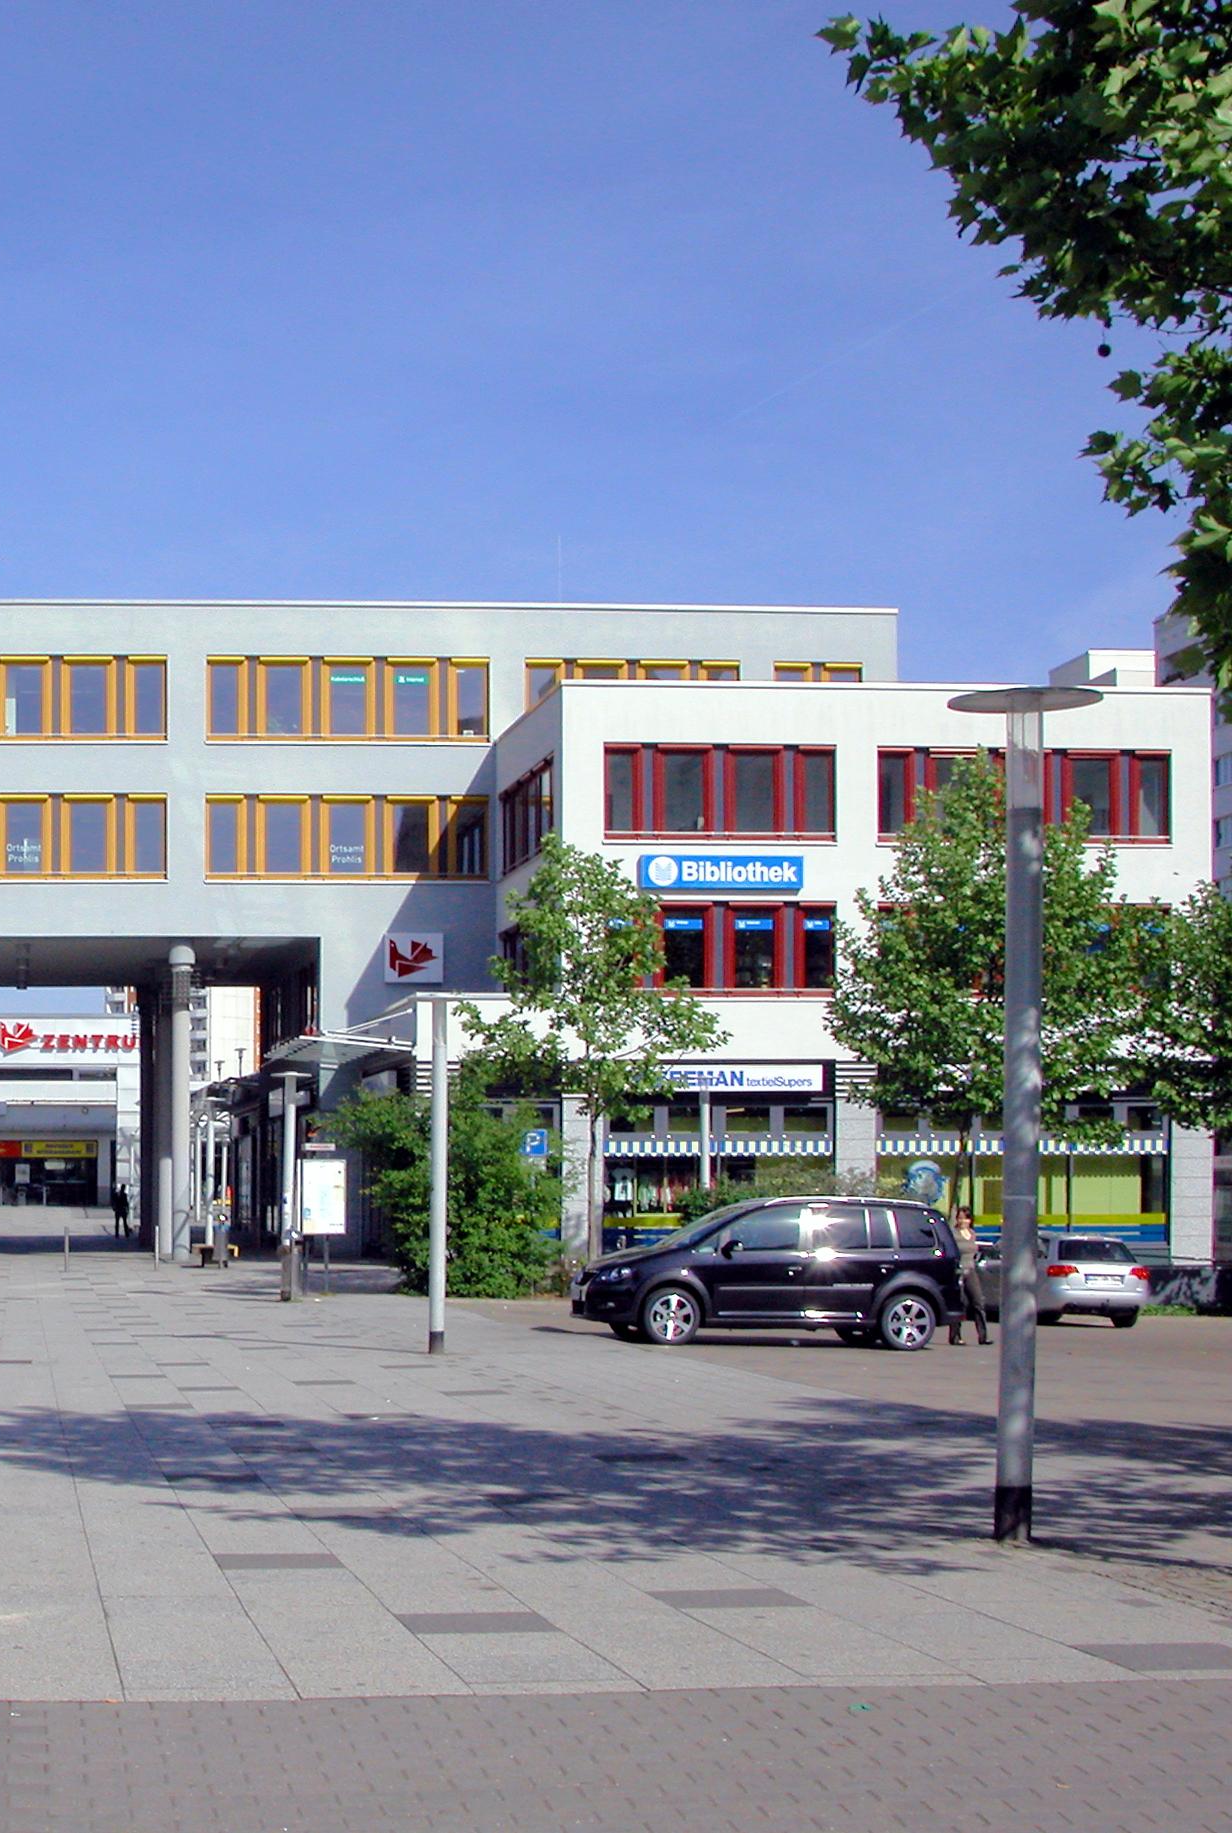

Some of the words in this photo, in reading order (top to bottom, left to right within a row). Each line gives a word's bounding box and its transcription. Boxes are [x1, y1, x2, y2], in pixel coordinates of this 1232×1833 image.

[329, 844, 364, 853] Ortsamt
[331, 854, 362, 864] Prohlis
[681, 860, 798, 882] Bibliothek
[41, 1034, 136, 1051] ZENTRU
[658, 1070, 745, 1087] EEMAN
[526, 1132, 540, 1152] P
